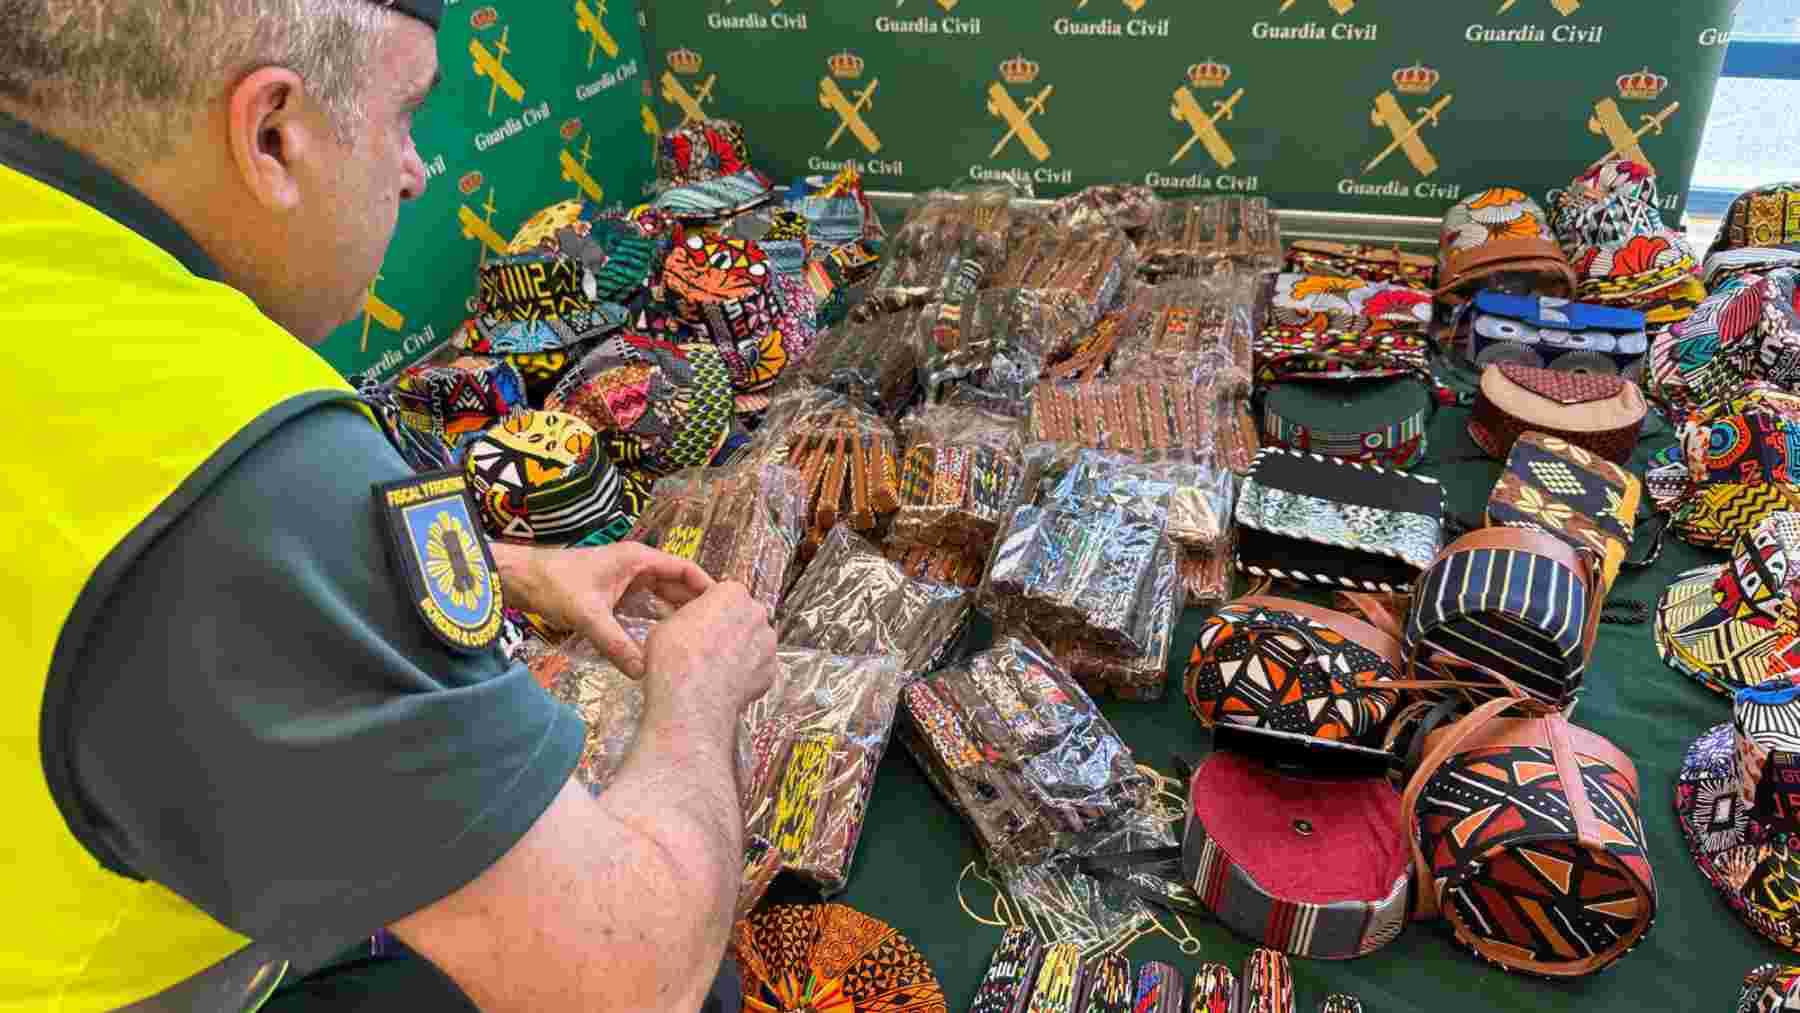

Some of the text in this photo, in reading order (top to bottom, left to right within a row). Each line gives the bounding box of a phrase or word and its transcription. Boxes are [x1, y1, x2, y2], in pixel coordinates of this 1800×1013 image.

[707, 13, 808, 29] Guardia Civil
[875, 16, 981, 34] Guardia Civil
[1053, 18, 1169, 37] Guardia Civil
[1251, 22, 1377, 41] Guardia Civil
[1464, 24, 1603, 43] Guardia Civil
[575, 58, 638, 101] Guardia Civil
[474, 101, 551, 152] Guardia Civil
[867, 159, 904, 177] Civil
[1033, 167, 1073, 184] Civil
[1144, 171, 1259, 191] Guardia Civil
[1337, 178, 1461, 201] Guardia Civil
[402, 322, 436, 355] Civil
